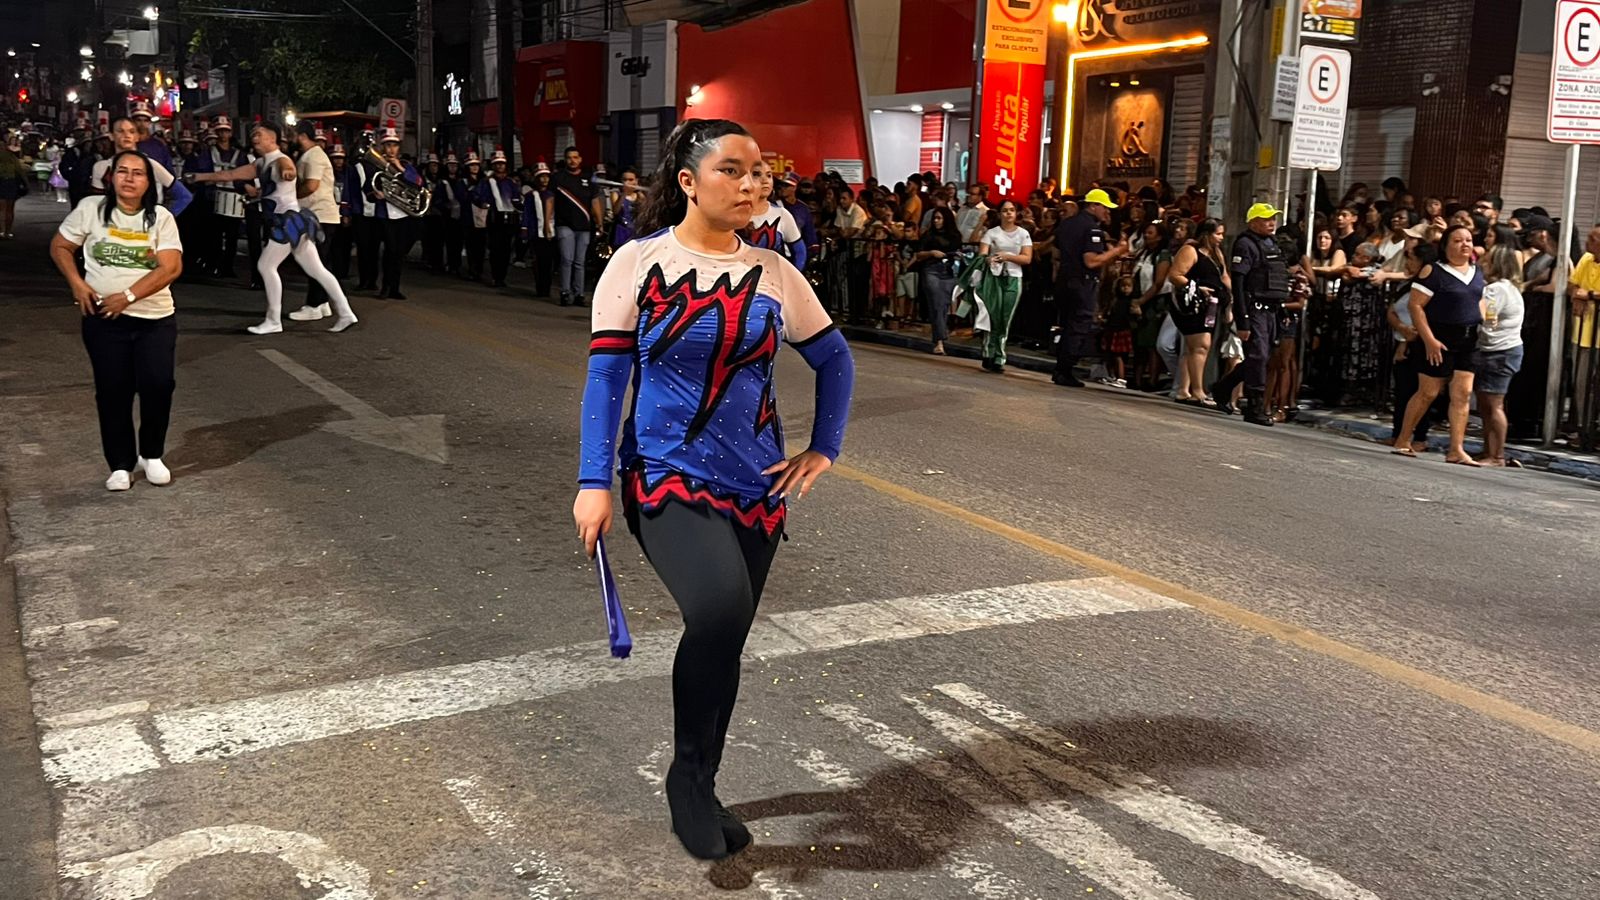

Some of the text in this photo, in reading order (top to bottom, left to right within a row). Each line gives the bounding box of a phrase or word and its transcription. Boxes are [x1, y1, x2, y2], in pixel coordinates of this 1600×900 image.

[1578, 22, 1591, 51] E
[1318, 66, 1330, 91] E
[1558, 83, 1600, 94] ZONA AZU
[995, 94, 1019, 169] Ultra
[1018, 97, 1029, 142] Popular
